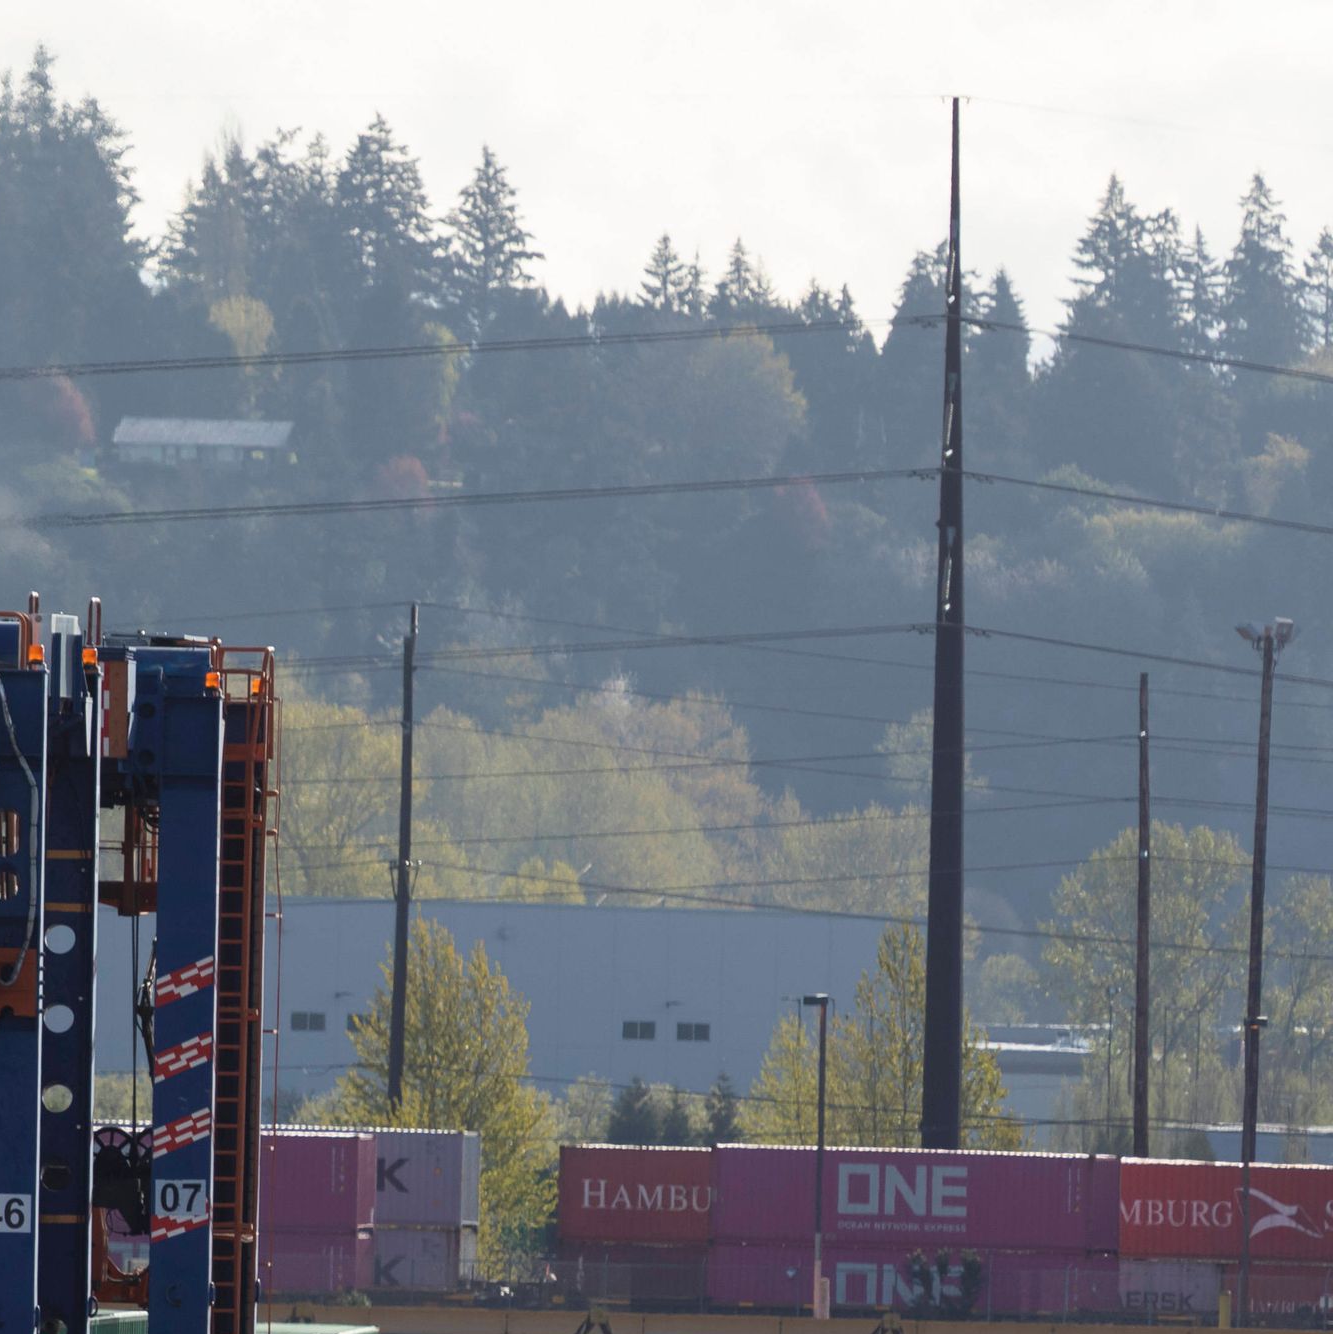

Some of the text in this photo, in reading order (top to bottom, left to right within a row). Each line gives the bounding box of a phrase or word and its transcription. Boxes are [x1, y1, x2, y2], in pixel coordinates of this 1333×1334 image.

[160, 1182, 202, 1212] 07
[837, 1163, 967, 1217] ONE
[837, 1220, 966, 1233] OCEAN NETWORK EXPRESS
[1121, 1291, 1194, 1313] ERSK
